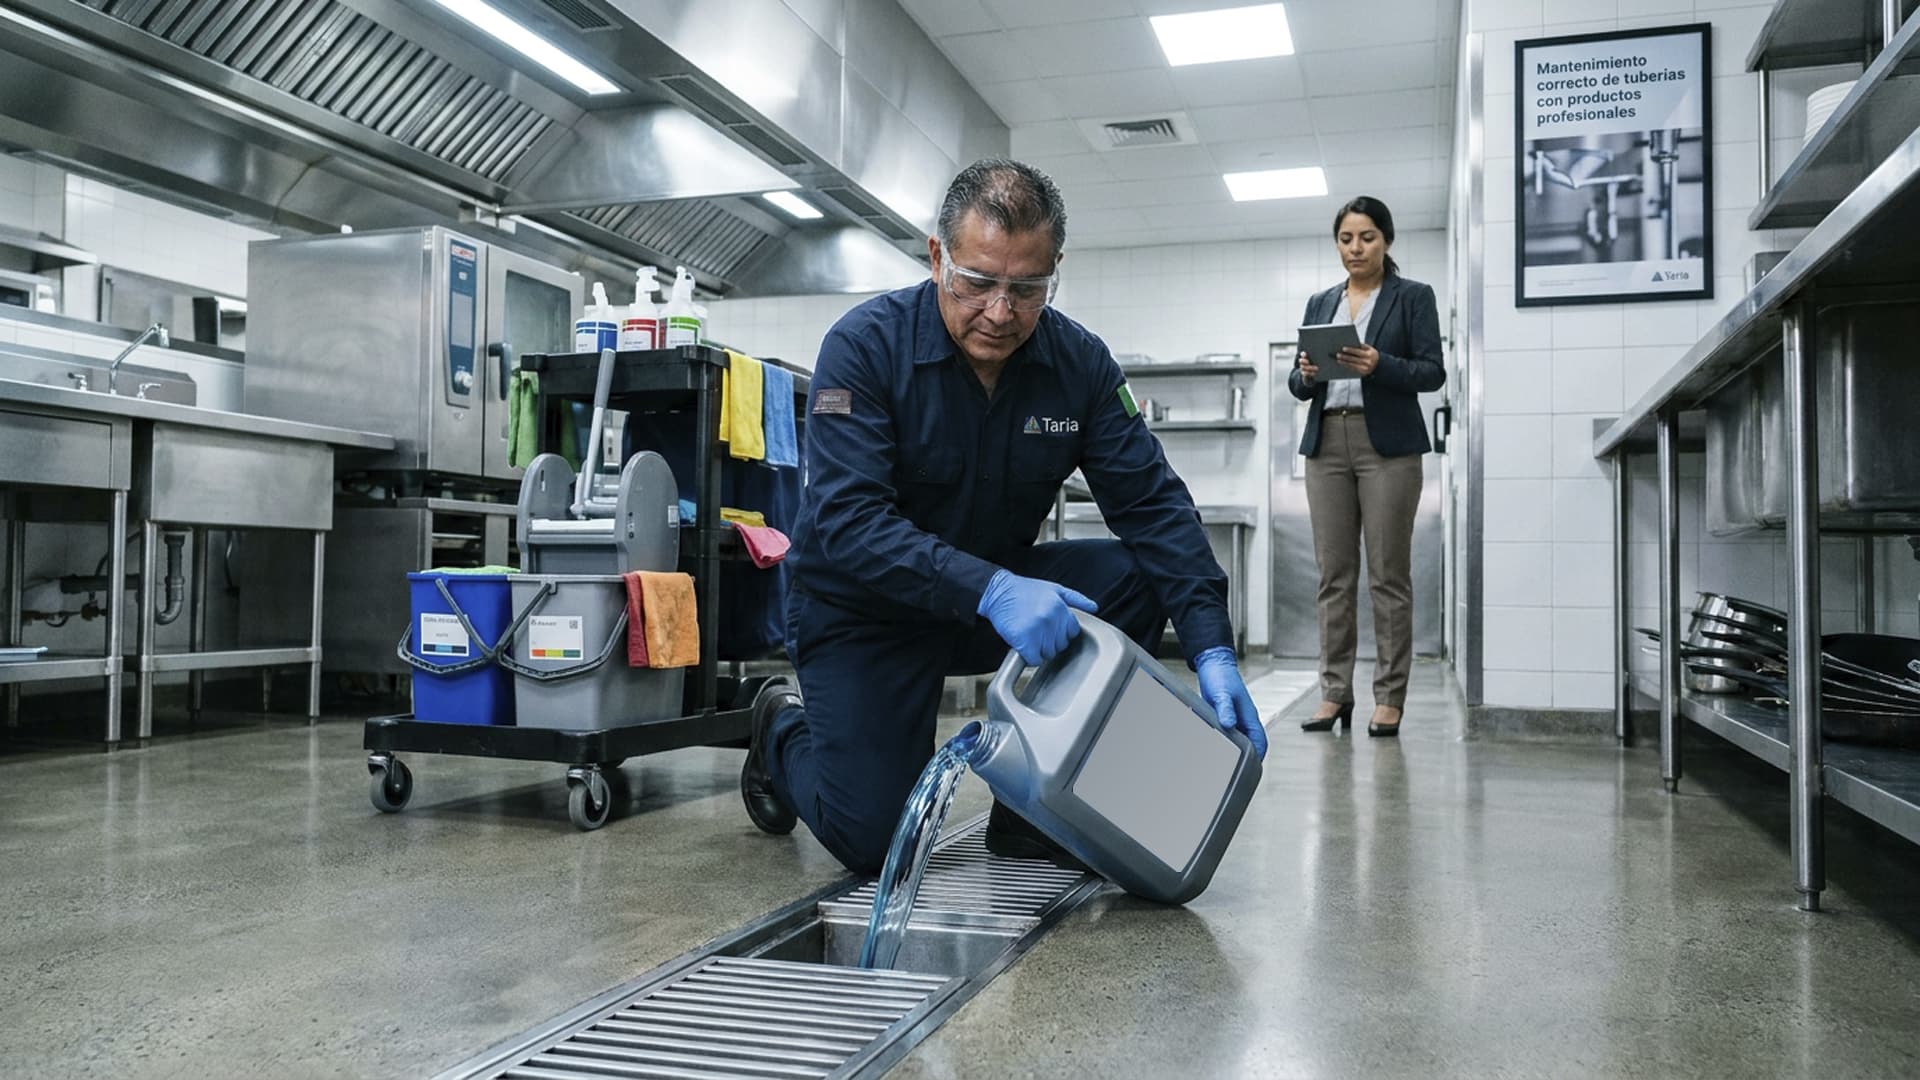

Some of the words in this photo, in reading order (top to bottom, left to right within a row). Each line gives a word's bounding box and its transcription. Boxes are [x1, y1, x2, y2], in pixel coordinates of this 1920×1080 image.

[1536, 56, 1647, 75] Mantenimiento
[1536, 76, 1597, 91] correcto
[1602, 73, 1620, 86] de
[1624, 68, 1686, 84] tuberias
[1536, 95, 1563, 107] con
[1567, 90, 1642, 108] productos
[1536, 106, 1637, 127] profesionales
[1041, 417, 1079, 433] Taria
